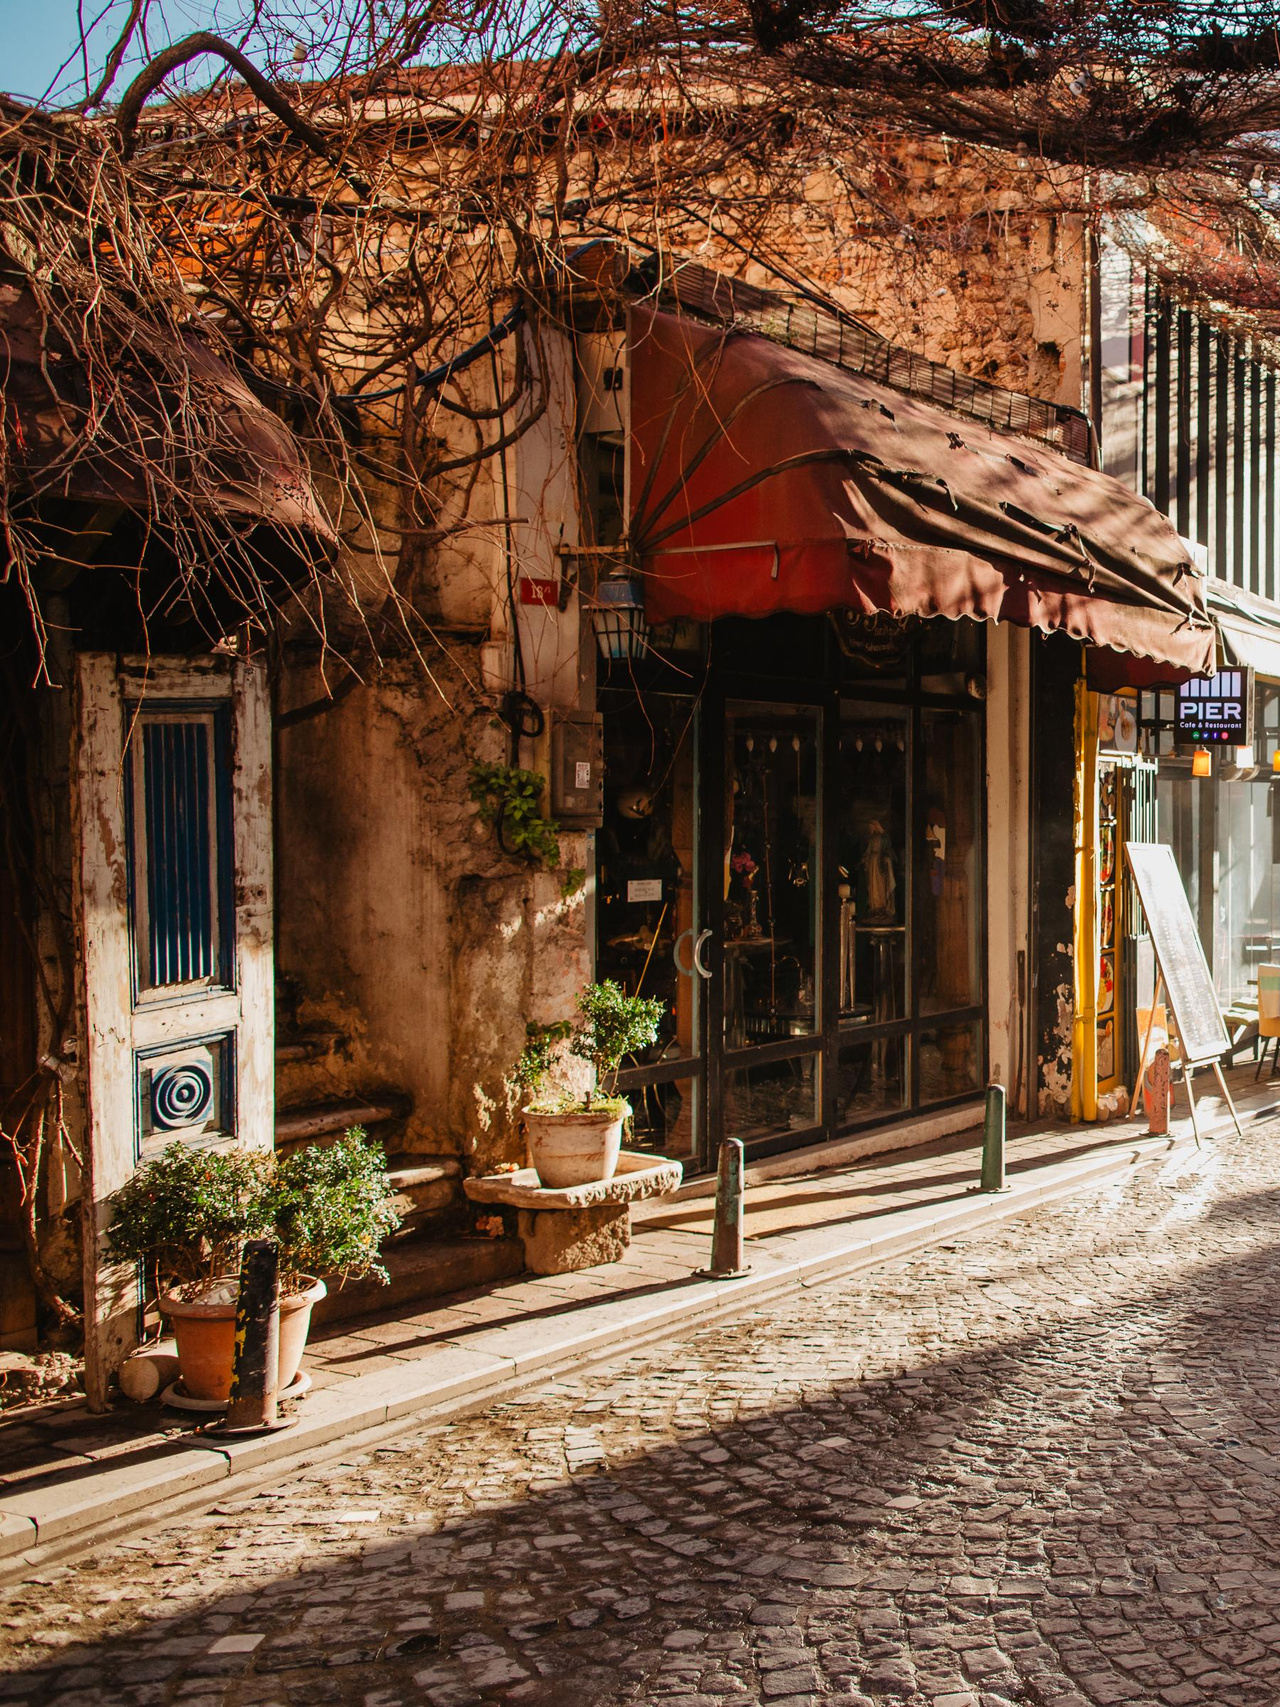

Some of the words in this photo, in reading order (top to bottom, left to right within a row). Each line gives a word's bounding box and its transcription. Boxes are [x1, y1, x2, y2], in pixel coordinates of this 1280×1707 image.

[1180, 702, 1242, 719] PIER
[1180, 721, 1196, 729] Cafe
[1198, 721, 1203, 729] &
[1205, 721, 1242, 729] Restaurant
